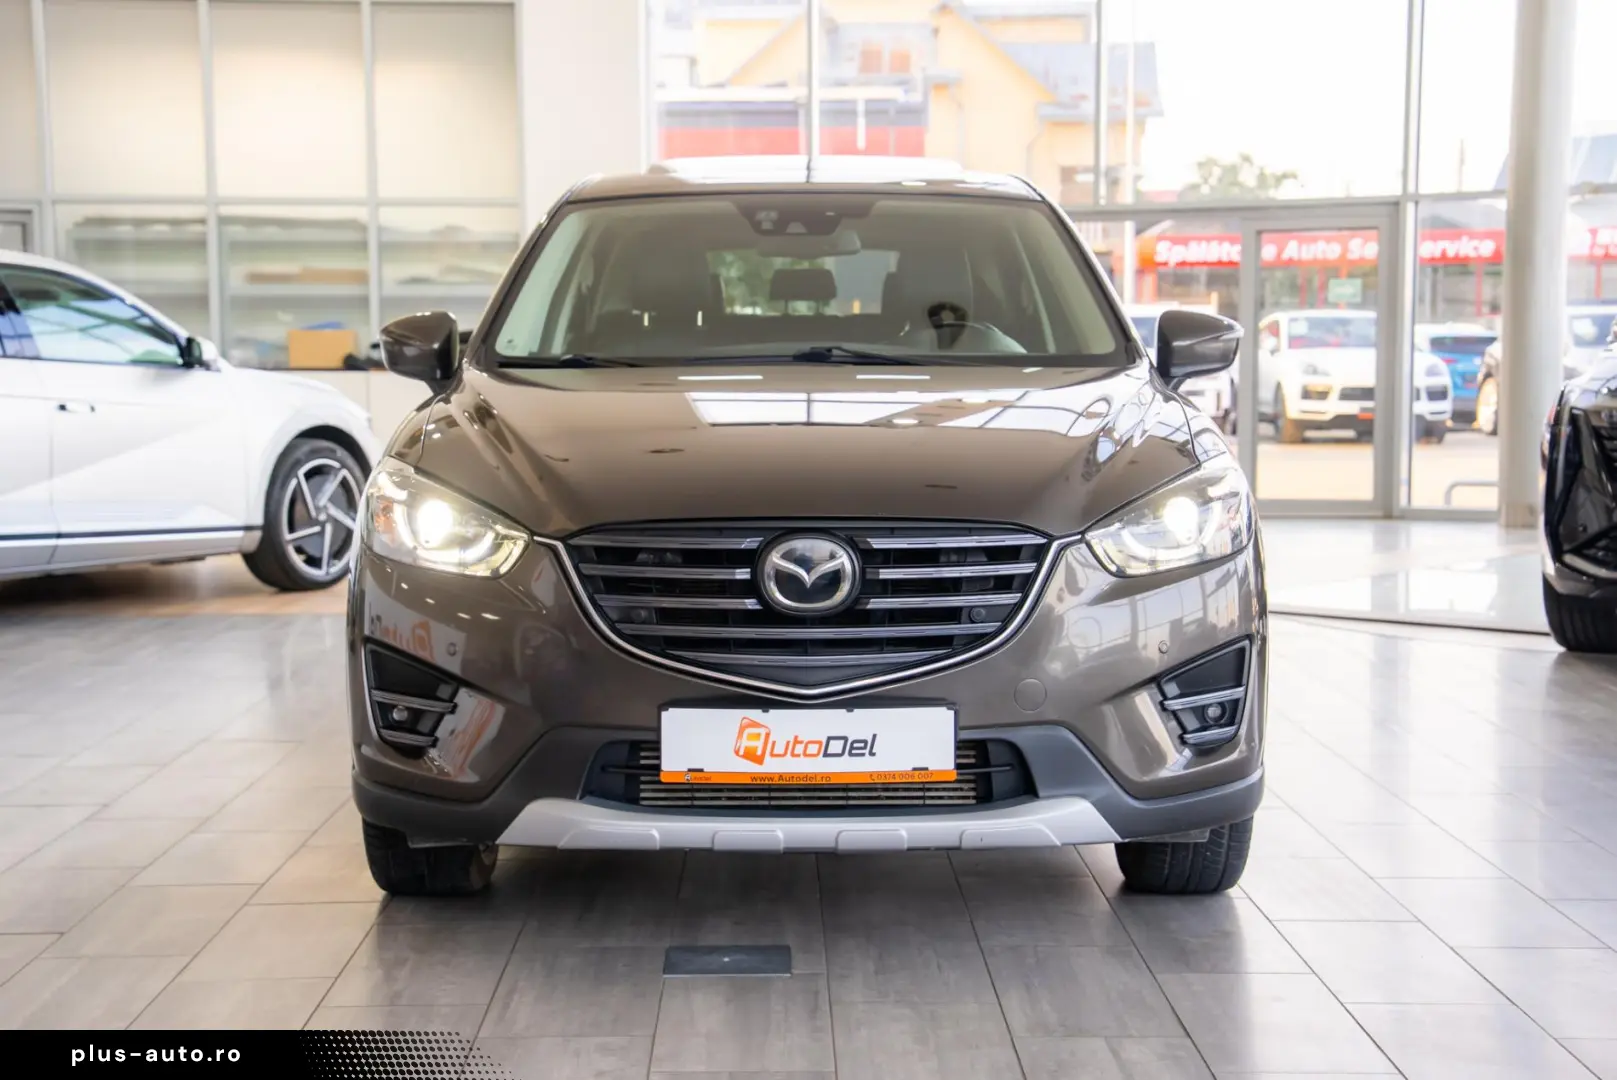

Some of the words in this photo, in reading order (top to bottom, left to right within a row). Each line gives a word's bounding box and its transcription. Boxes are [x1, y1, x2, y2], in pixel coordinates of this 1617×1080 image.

[1280, 239, 1342, 261] Auto
[1418, 235, 1496, 258] ervice
[736, 725, 877, 759] AutoDel
[750, 774, 832, 783] www.Autodel.ro
[917, 772, 934, 780] 007
